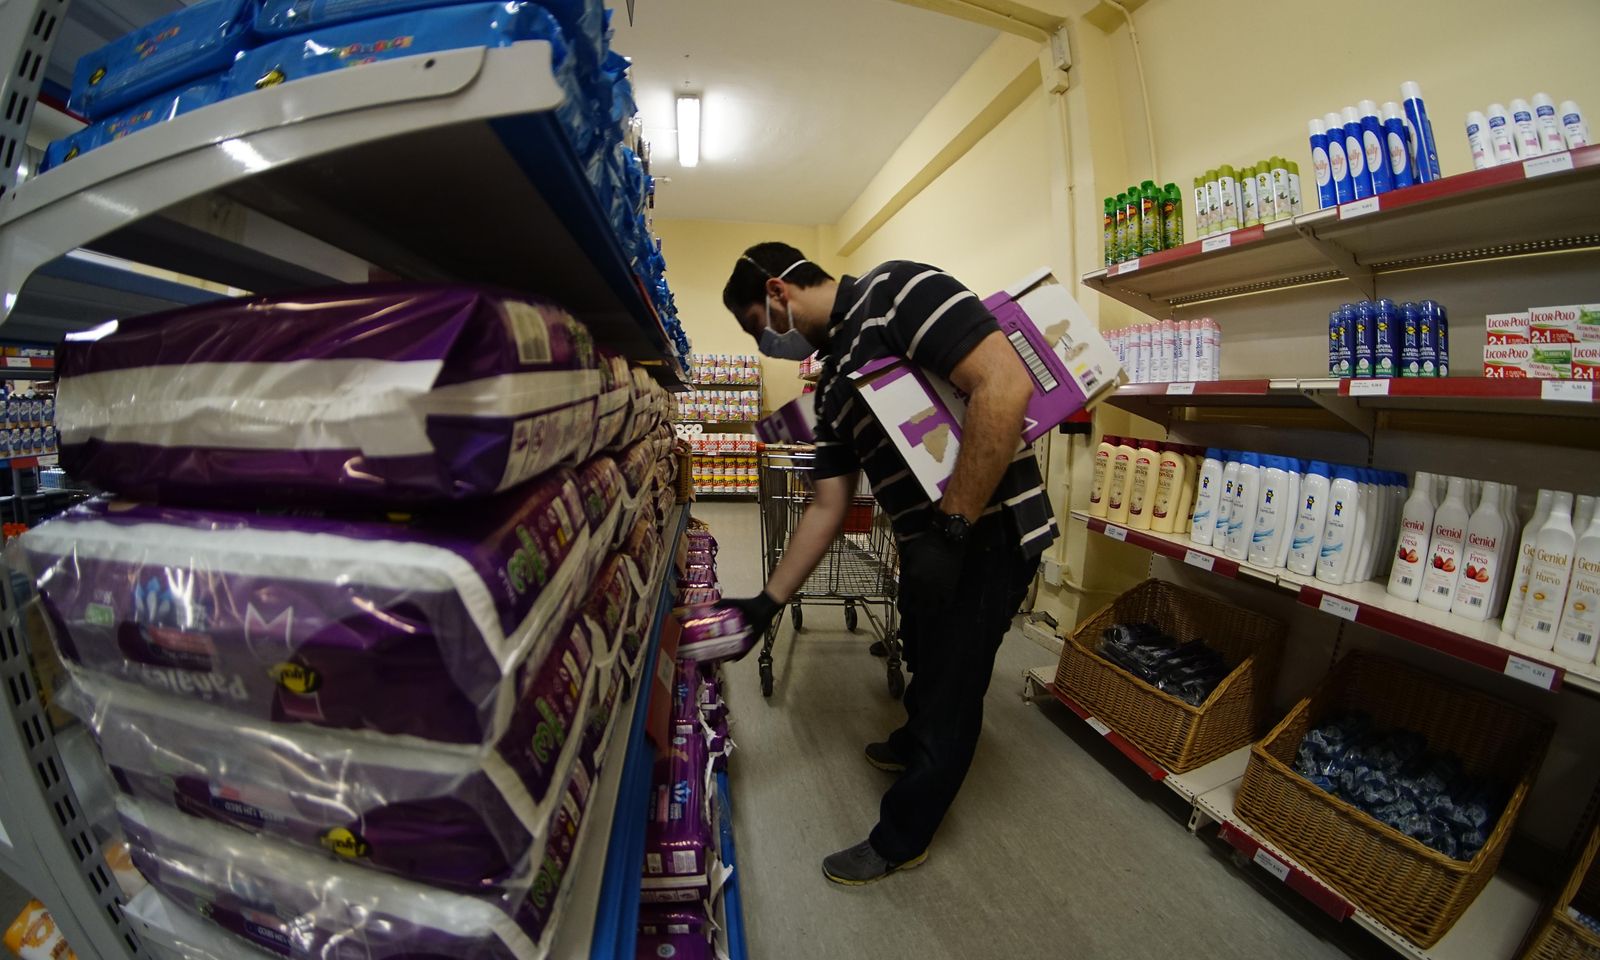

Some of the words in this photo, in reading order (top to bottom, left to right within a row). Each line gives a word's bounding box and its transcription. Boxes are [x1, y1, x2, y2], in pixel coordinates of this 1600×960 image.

[1531, 330, 1551, 344] 2x1
[1485, 367, 1504, 378] 2x1
[1573, 367, 1594, 378] 2x1
[1402, 518, 1425, 531] Geniol
[1436, 524, 1462, 539] Geniol
[1402, 536, 1417, 546] Fresa
[1469, 533, 1496, 548] Geniol
[1436, 544, 1455, 555] Fresa
[1469, 553, 1488, 565] Fresa
[1537, 549, 1568, 565] Geniol
[1536, 571, 1561, 585] Huevo
[149, 665, 249, 701] Pañales
